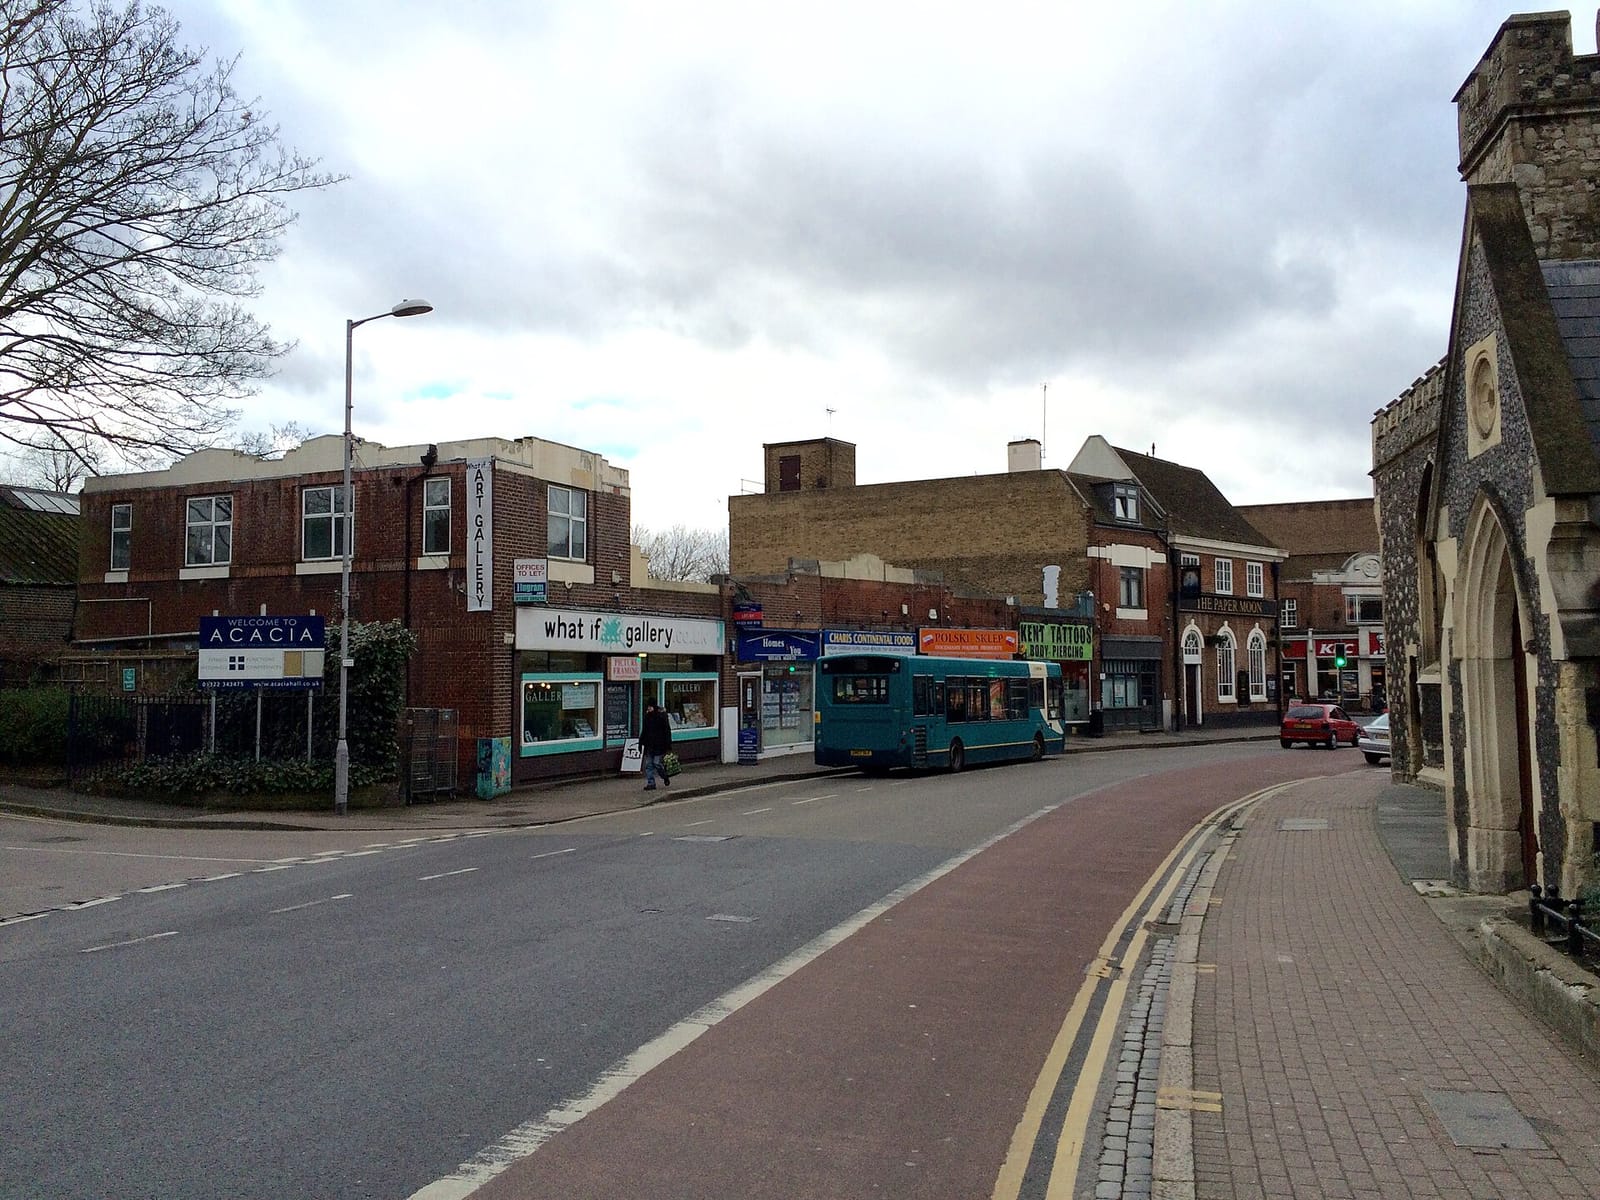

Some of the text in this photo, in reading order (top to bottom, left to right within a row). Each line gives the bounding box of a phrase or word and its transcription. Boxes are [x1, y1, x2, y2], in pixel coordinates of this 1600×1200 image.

[474, 469, 484, 607] ART GALLERY
[1197, 597, 1263, 613] THE PAPER MOON
[544, 615, 584, 640] what
[590, 618, 602, 641] if
[1020, 624, 1092, 644] KENT TATTOOS
[210, 628, 313, 642] ACACIA
[853, 633, 893, 645] CONTINENTAL
[894, 635, 914, 645] FOODS
[935, 633, 1003, 644] POLSKI SKLEP
[762, 638, 785, 648] Homes
[1320, 643, 1354, 654] KC
[1030, 645, 1083, 658] BODY PIERCING
[612, 667, 640, 675] FRAMING
